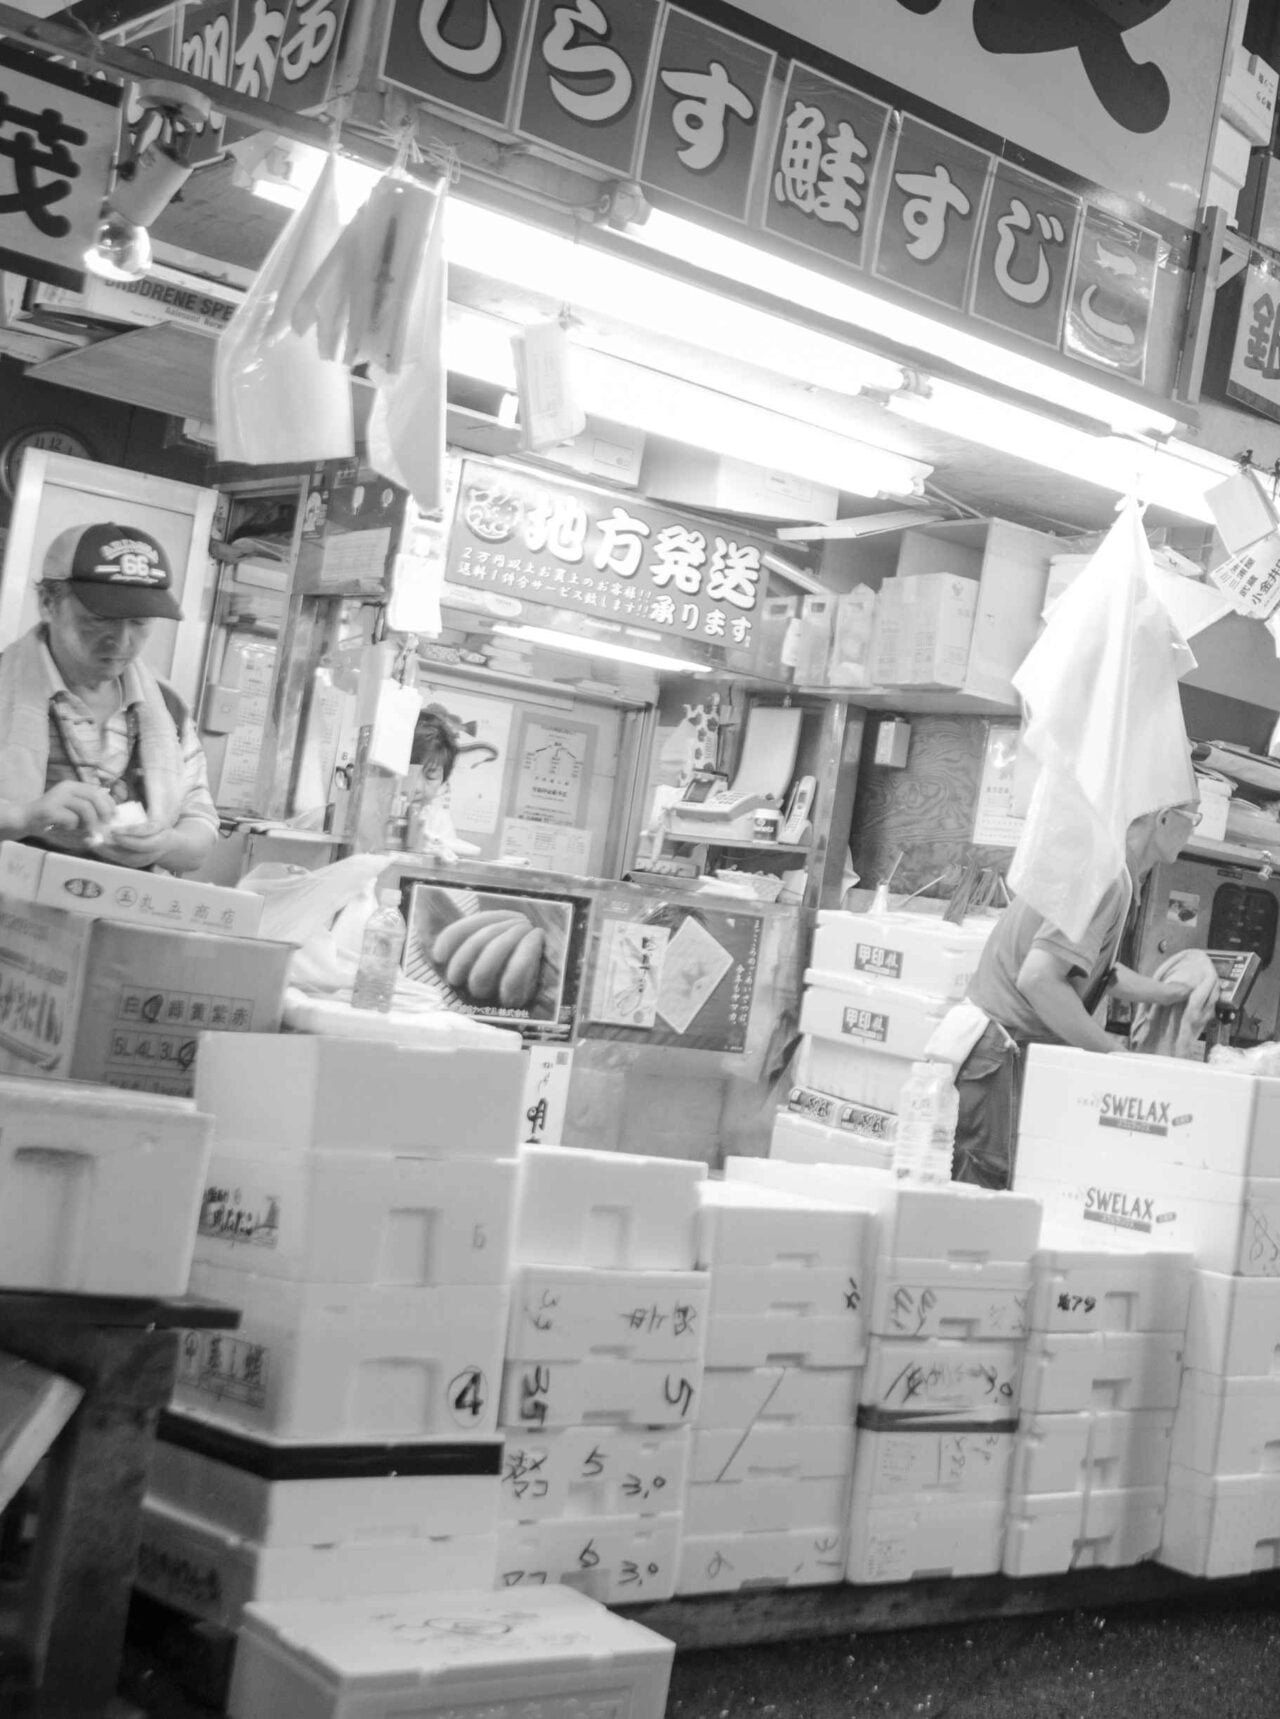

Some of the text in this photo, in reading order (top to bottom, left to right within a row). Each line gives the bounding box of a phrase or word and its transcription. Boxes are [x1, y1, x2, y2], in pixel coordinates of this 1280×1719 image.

[120, 554, 149, 577] 66
[524, 496, 761, 609] 地方発送
[650, 595, 751, 643] 承ります
[1099, 1093, 1171, 1125] SWELAX
[1085, 1187, 1154, 1221] SWELAX
[455, 1372, 484, 1416] 4
